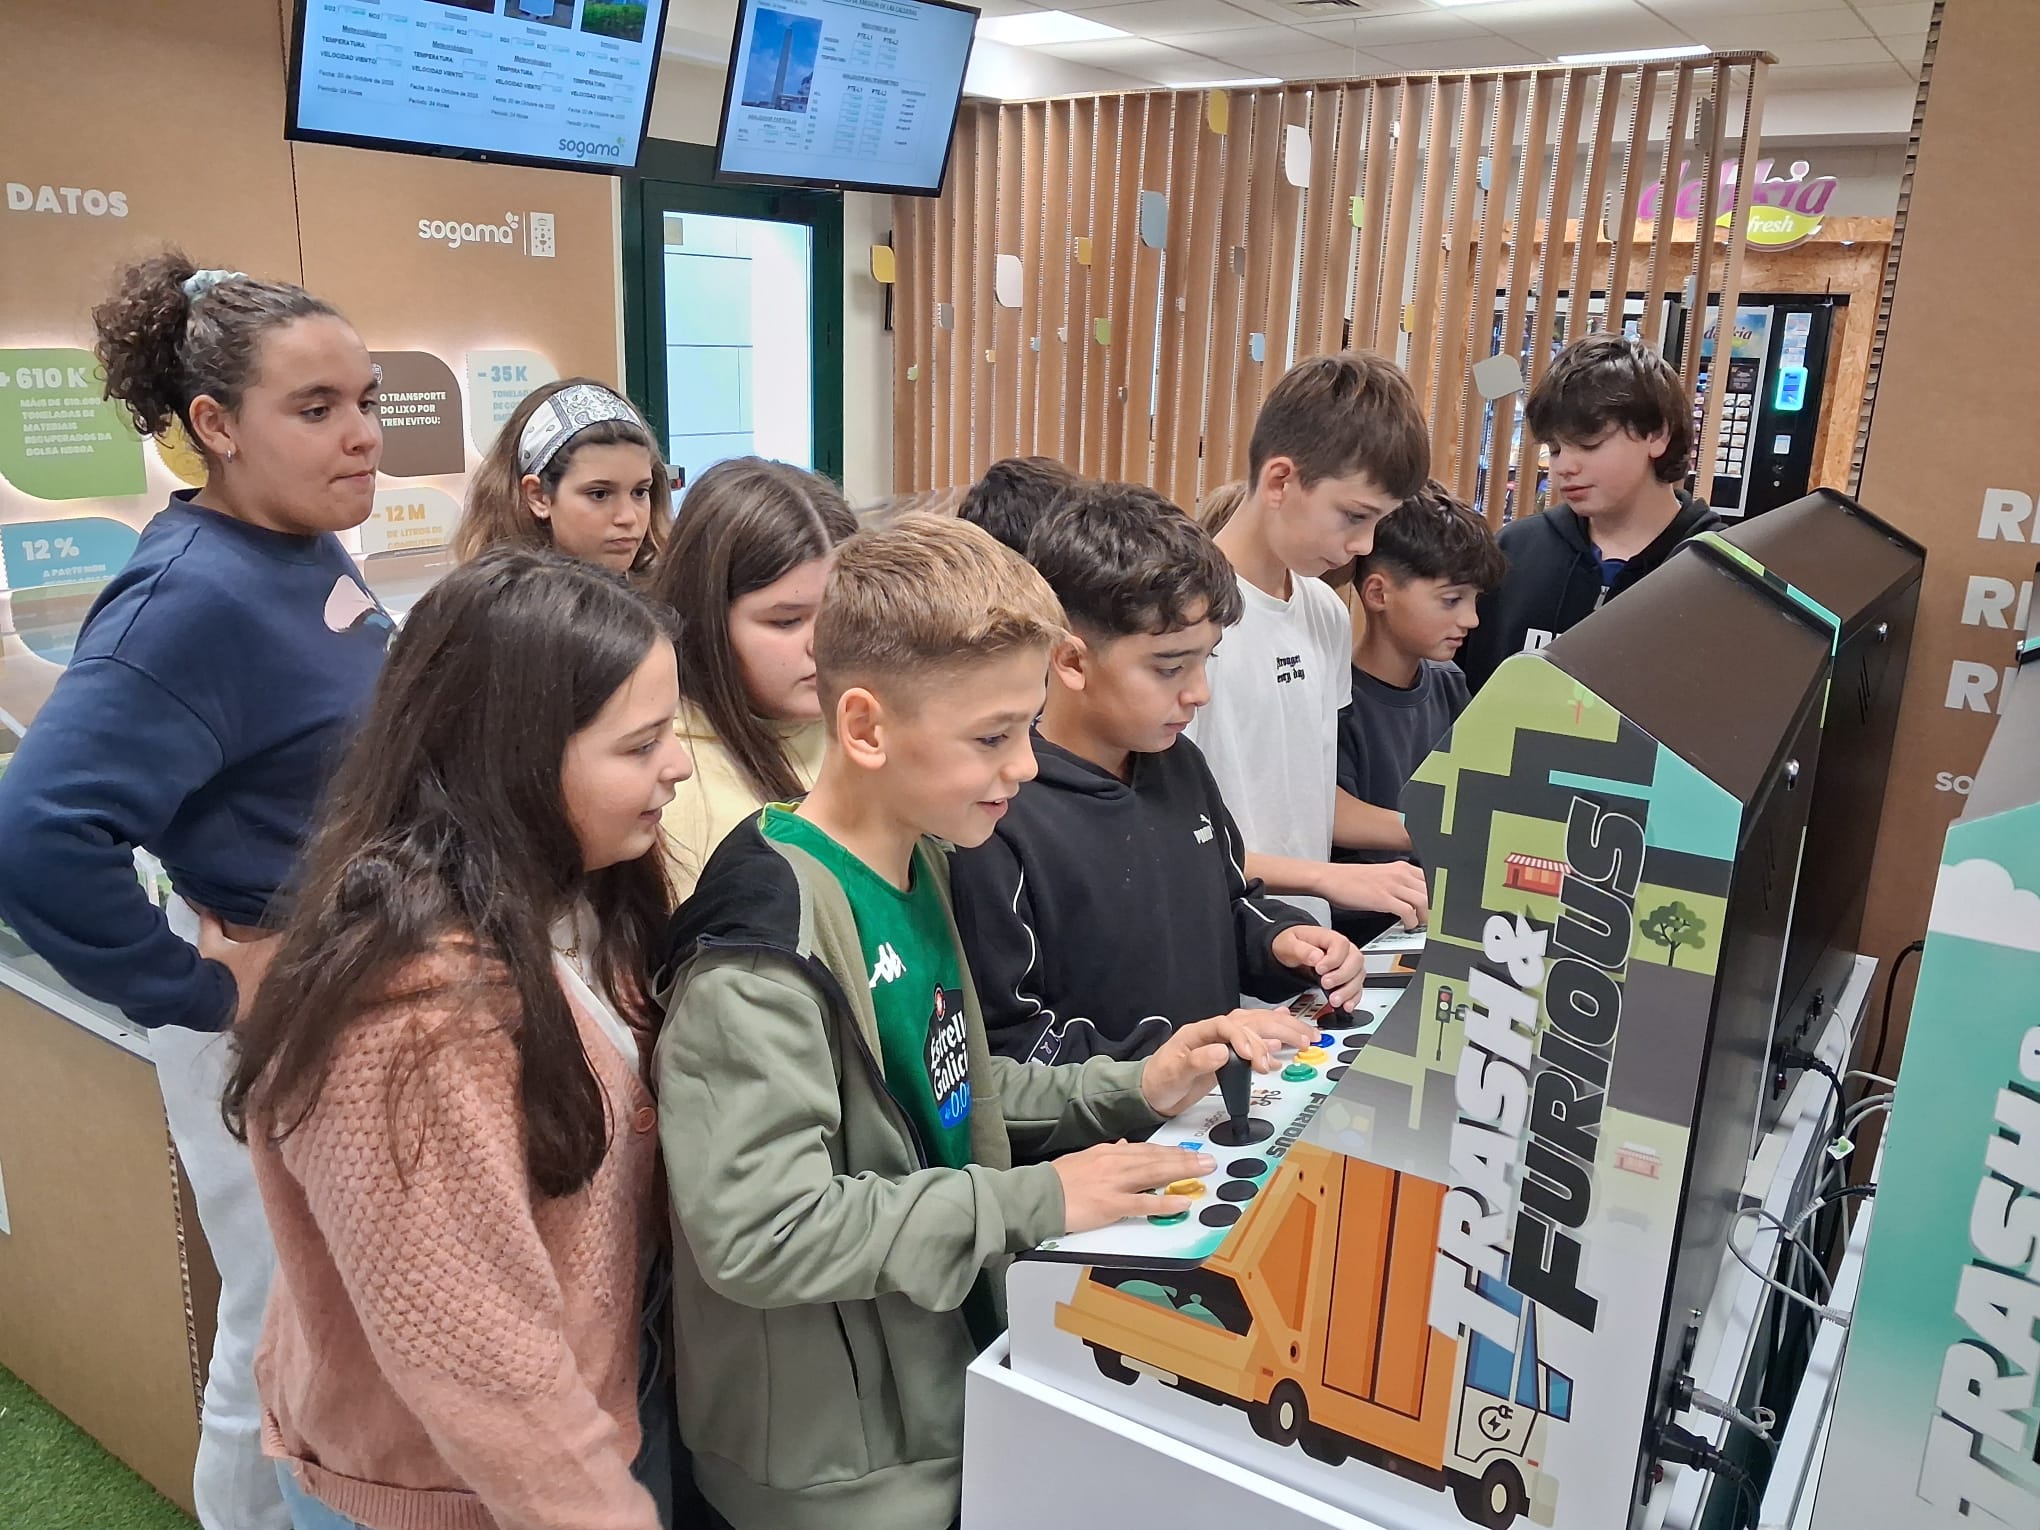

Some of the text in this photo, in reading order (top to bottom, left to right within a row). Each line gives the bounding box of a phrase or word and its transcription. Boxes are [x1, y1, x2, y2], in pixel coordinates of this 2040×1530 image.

[558, 138, 620, 158] sogama
[6, 182, 129, 218] DATOS
[418, 219, 513, 248] sogama
[16, 367, 62, 389] 610
[67, 367, 88, 388] K
[491, 366, 512, 382] 35
[516, 366, 528, 382] K
[380, 391, 447, 402] O TRANSPORTE
[381, 404, 436, 415] DO LIXO POR
[381, 416, 441, 427] TREN EVITOU:
[385, 505, 405, 522] 12
[408, 503, 426, 521] M
[22, 537, 80, 561] 12 %
[1506, 795, 1646, 1334] FURIOUS
[1266, 1092, 1328, 1159] FURIOUS
[1428, 910, 1549, 1354] TRASH &
